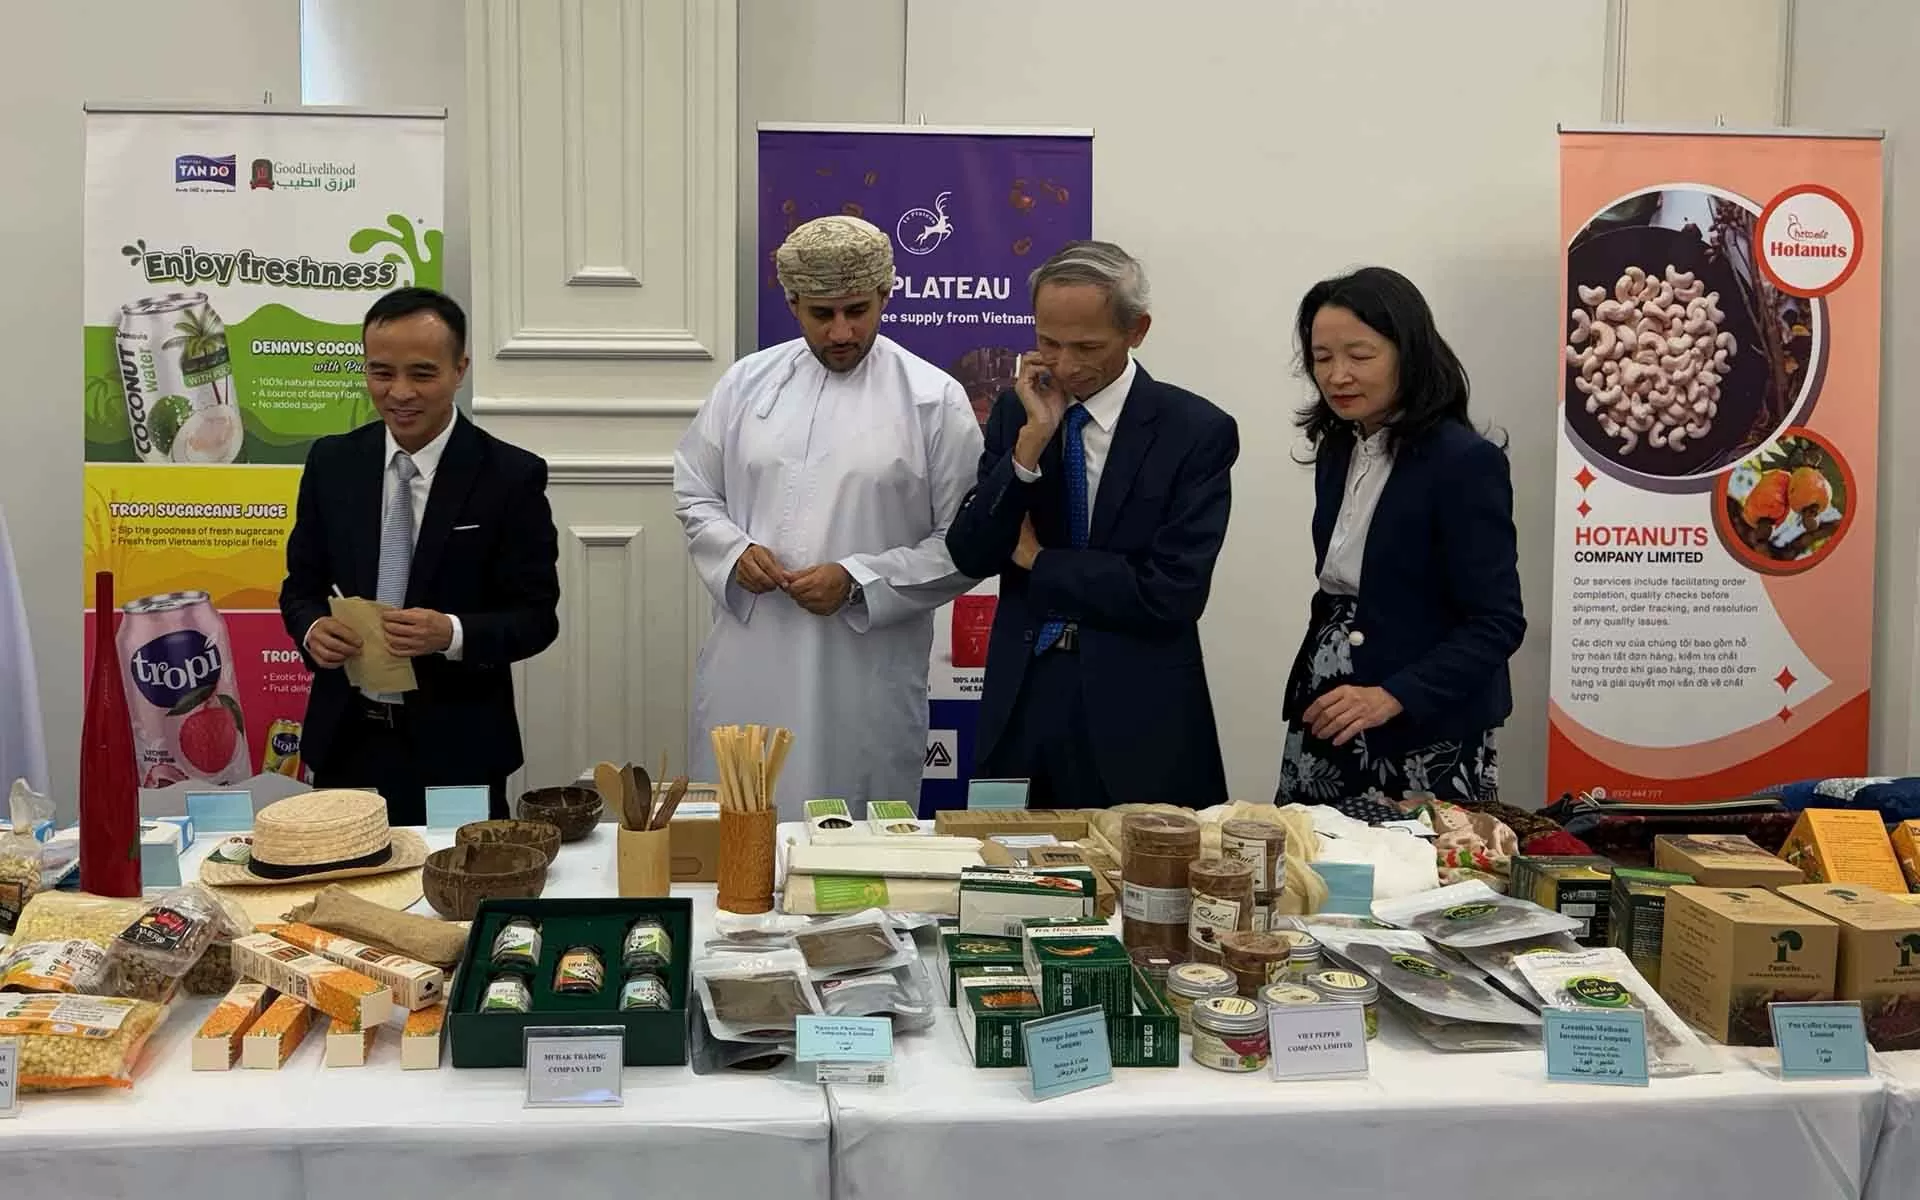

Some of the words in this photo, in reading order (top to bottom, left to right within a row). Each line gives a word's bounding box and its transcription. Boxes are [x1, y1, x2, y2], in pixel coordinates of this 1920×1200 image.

[179, 165, 207, 177] TAN
[210, 165, 229, 177] DO
[273, 161, 355, 176] GoodLivelihood
[276, 177, 321, 190] الطيب
[325, 178, 355, 192] الرزق
[1770, 240, 1848, 259] Hotanuts
[145, 246, 235, 284] Enjoy
[237, 249, 397, 289] freshness
[889, 276, 1011, 299] PLATEAU
[900, 311, 944, 325] supply
[947, 311, 978, 324] from
[982, 311, 1036, 324] Vietnam
[252, 340, 314, 355] DENAVIS
[316, 341, 365, 356] COCON
[138, 347, 158, 393] water
[313, 360, 340, 373] with
[344, 359, 367, 374] Pu
[259, 378, 283, 387] 100%
[284, 378, 315, 388] natural
[316, 379, 353, 388] coconut
[118, 344, 152, 454] COCONUT
[267, 391, 295, 399] source
[298, 390, 307, 398] of
[309, 390, 339, 401] dietary
[259, 400, 272, 409] No
[273, 400, 300, 409] added
[302, 402, 326, 412] sugar
[110, 503, 154, 518] TROPI
[155, 503, 242, 519] SUGARCANE
[243, 503, 288, 519] JUICE
[118, 525, 133, 537] Sip
[135, 526, 150, 535] the
[151, 526, 197, 537] goodness
[199, 526, 208, 535] of
[209, 526, 233, 536] fresh
[235, 527, 285, 538] sugarcane
[1575, 526, 1709, 547] HOTANUTS
[118, 537, 144, 546] Fresh
[146, 537, 167, 546] from
[168, 537, 212, 547] Vietnam's
[213, 537, 250, 549] tropical
[251, 537, 278, 546] fields
[1574, 551, 1643, 564] COMPANY
[1647, 551, 1704, 564] LIMITED
[1573, 577, 1590, 586] Our
[1592, 577, 1632, 586] services
[1634, 577, 1669, 586] include
[1671, 577, 1719, 587] facilitating
[1722, 577, 1746, 586] order
[1572, 591, 1628, 600] completion,
[1630, 591, 1661, 600] quality
[1664, 591, 1698, 599] checks
[1700, 591, 1730, 600] before
[1572, 604, 1618, 614] shipment,
[1621, 604, 1646, 612] order
[1648, 604, 1690, 614] tracking,
[1693, 604, 1711, 612] and
[1712, 603, 1759, 613] resolution
[1572, 617, 1582, 626] of
[1583, 618, 1600, 627] any
[1603, 617, 1635, 627] quality
[1571, 638, 1591, 647] Các
[1592, 639, 1613, 648] dịch
[1647, 638, 1677, 648] chúng
[1694, 639, 1712, 647] bao
[1713, 637, 1733, 648] gồm
[1703, 652, 1716, 660] tra
[1631, 665, 1645, 673] khi
[1647, 665, 1668, 675] giao
[1698, 665, 1719, 674] theo
[270, 672, 296, 681] Exotic
[970, 676, 984, 684] ARA
[270, 683, 290, 692] Fruit
[1287, 1044, 1321, 1053] COMPANY
[1323, 1042, 1353, 1051] LIMITED
[548, 1065, 586, 1073] COMPANY
